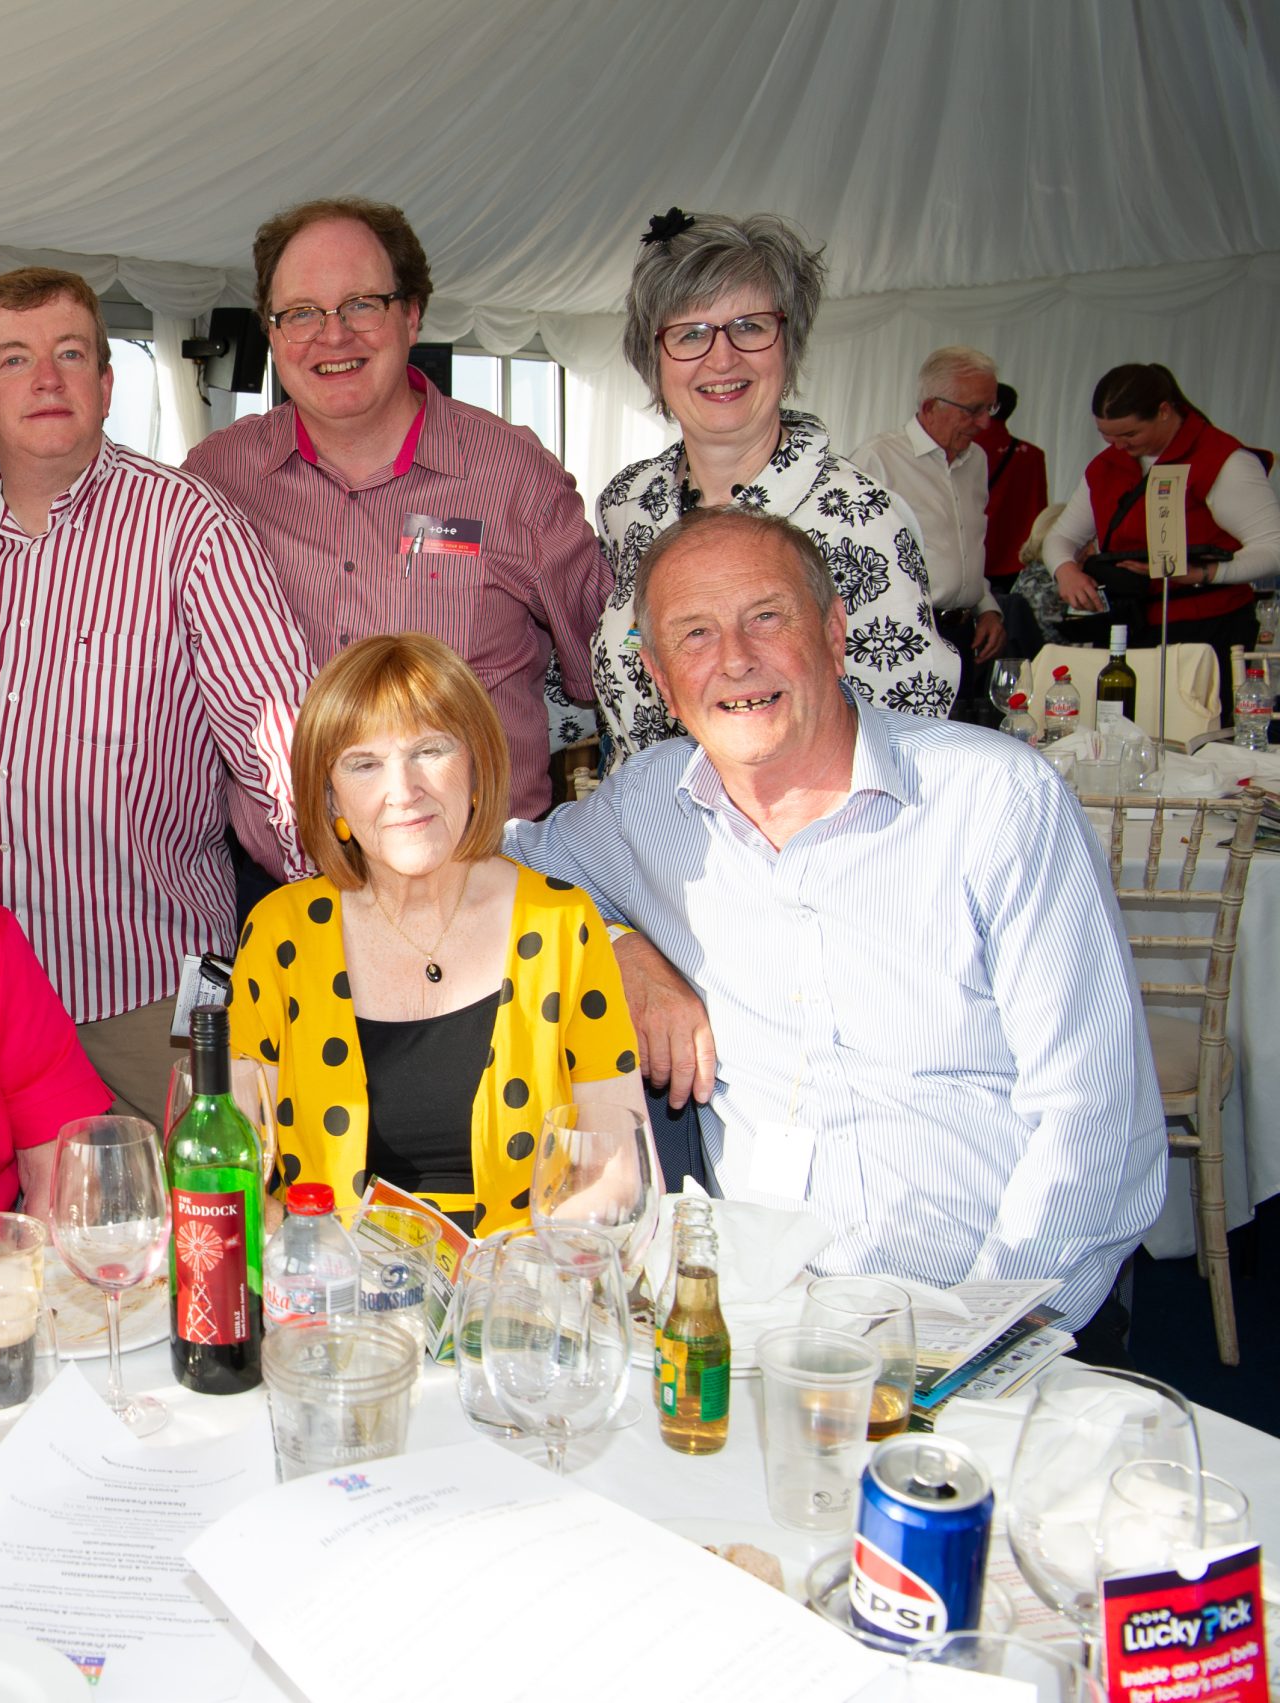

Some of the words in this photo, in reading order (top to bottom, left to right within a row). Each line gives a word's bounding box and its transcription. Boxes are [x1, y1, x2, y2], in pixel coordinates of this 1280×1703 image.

[429, 525, 458, 535] tote
[178, 1195, 191, 1204] THE
[178, 1203, 238, 1217] PADDOCK
[361, 1283, 425, 1312] ROCKSHORE
[233, 1310, 241, 1339] SHIRAZ
[853, 1575, 936, 1632] EPSI
[1124, 1616, 1202, 1652] Lucky
[1120, 1666, 1170, 1688] Inside
[1171, 1661, 1200, 1680] are
[1200, 1653, 1232, 1676] your
[1230, 1641, 1259, 1663] bets
[1154, 1677, 1212, 1702] today's
[1211, 1663, 1255, 1688] racing
